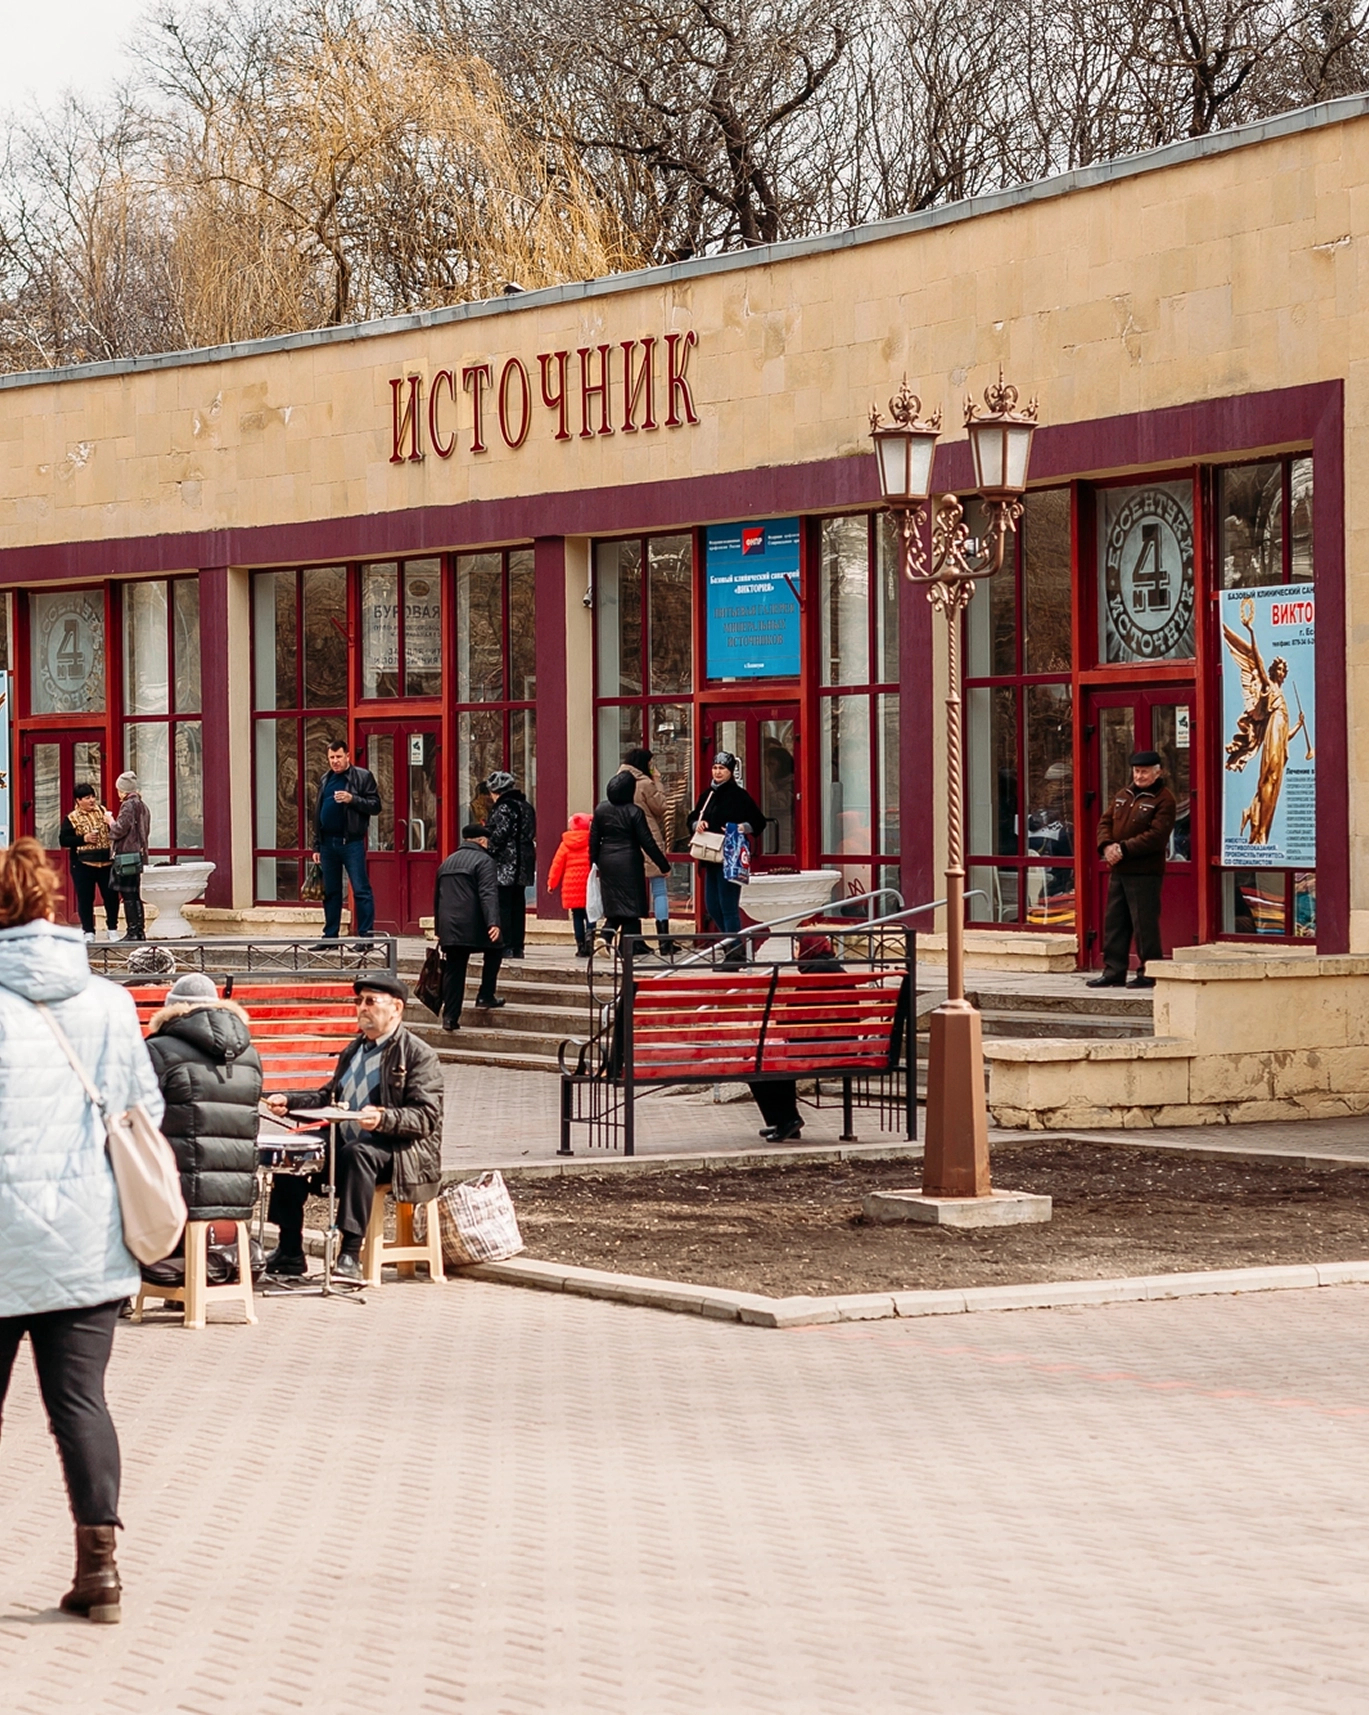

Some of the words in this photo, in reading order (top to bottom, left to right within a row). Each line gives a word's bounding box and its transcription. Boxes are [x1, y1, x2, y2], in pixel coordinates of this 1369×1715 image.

[388, 329, 699, 464] ИСТОЧНИК
[1108, 491, 1194, 569] ЕССЕНТУКИ
[1132, 523, 1171, 612] 4
[1257, 586, 1301, 598] КЛИНИЧЕСКИЙ
[727, 634, 784, 647] ИСТОЧНИКОВ
[1110, 580, 1195, 654] ИСТОЧНИК
[1272, 602, 1314, 625] ВИКТО
